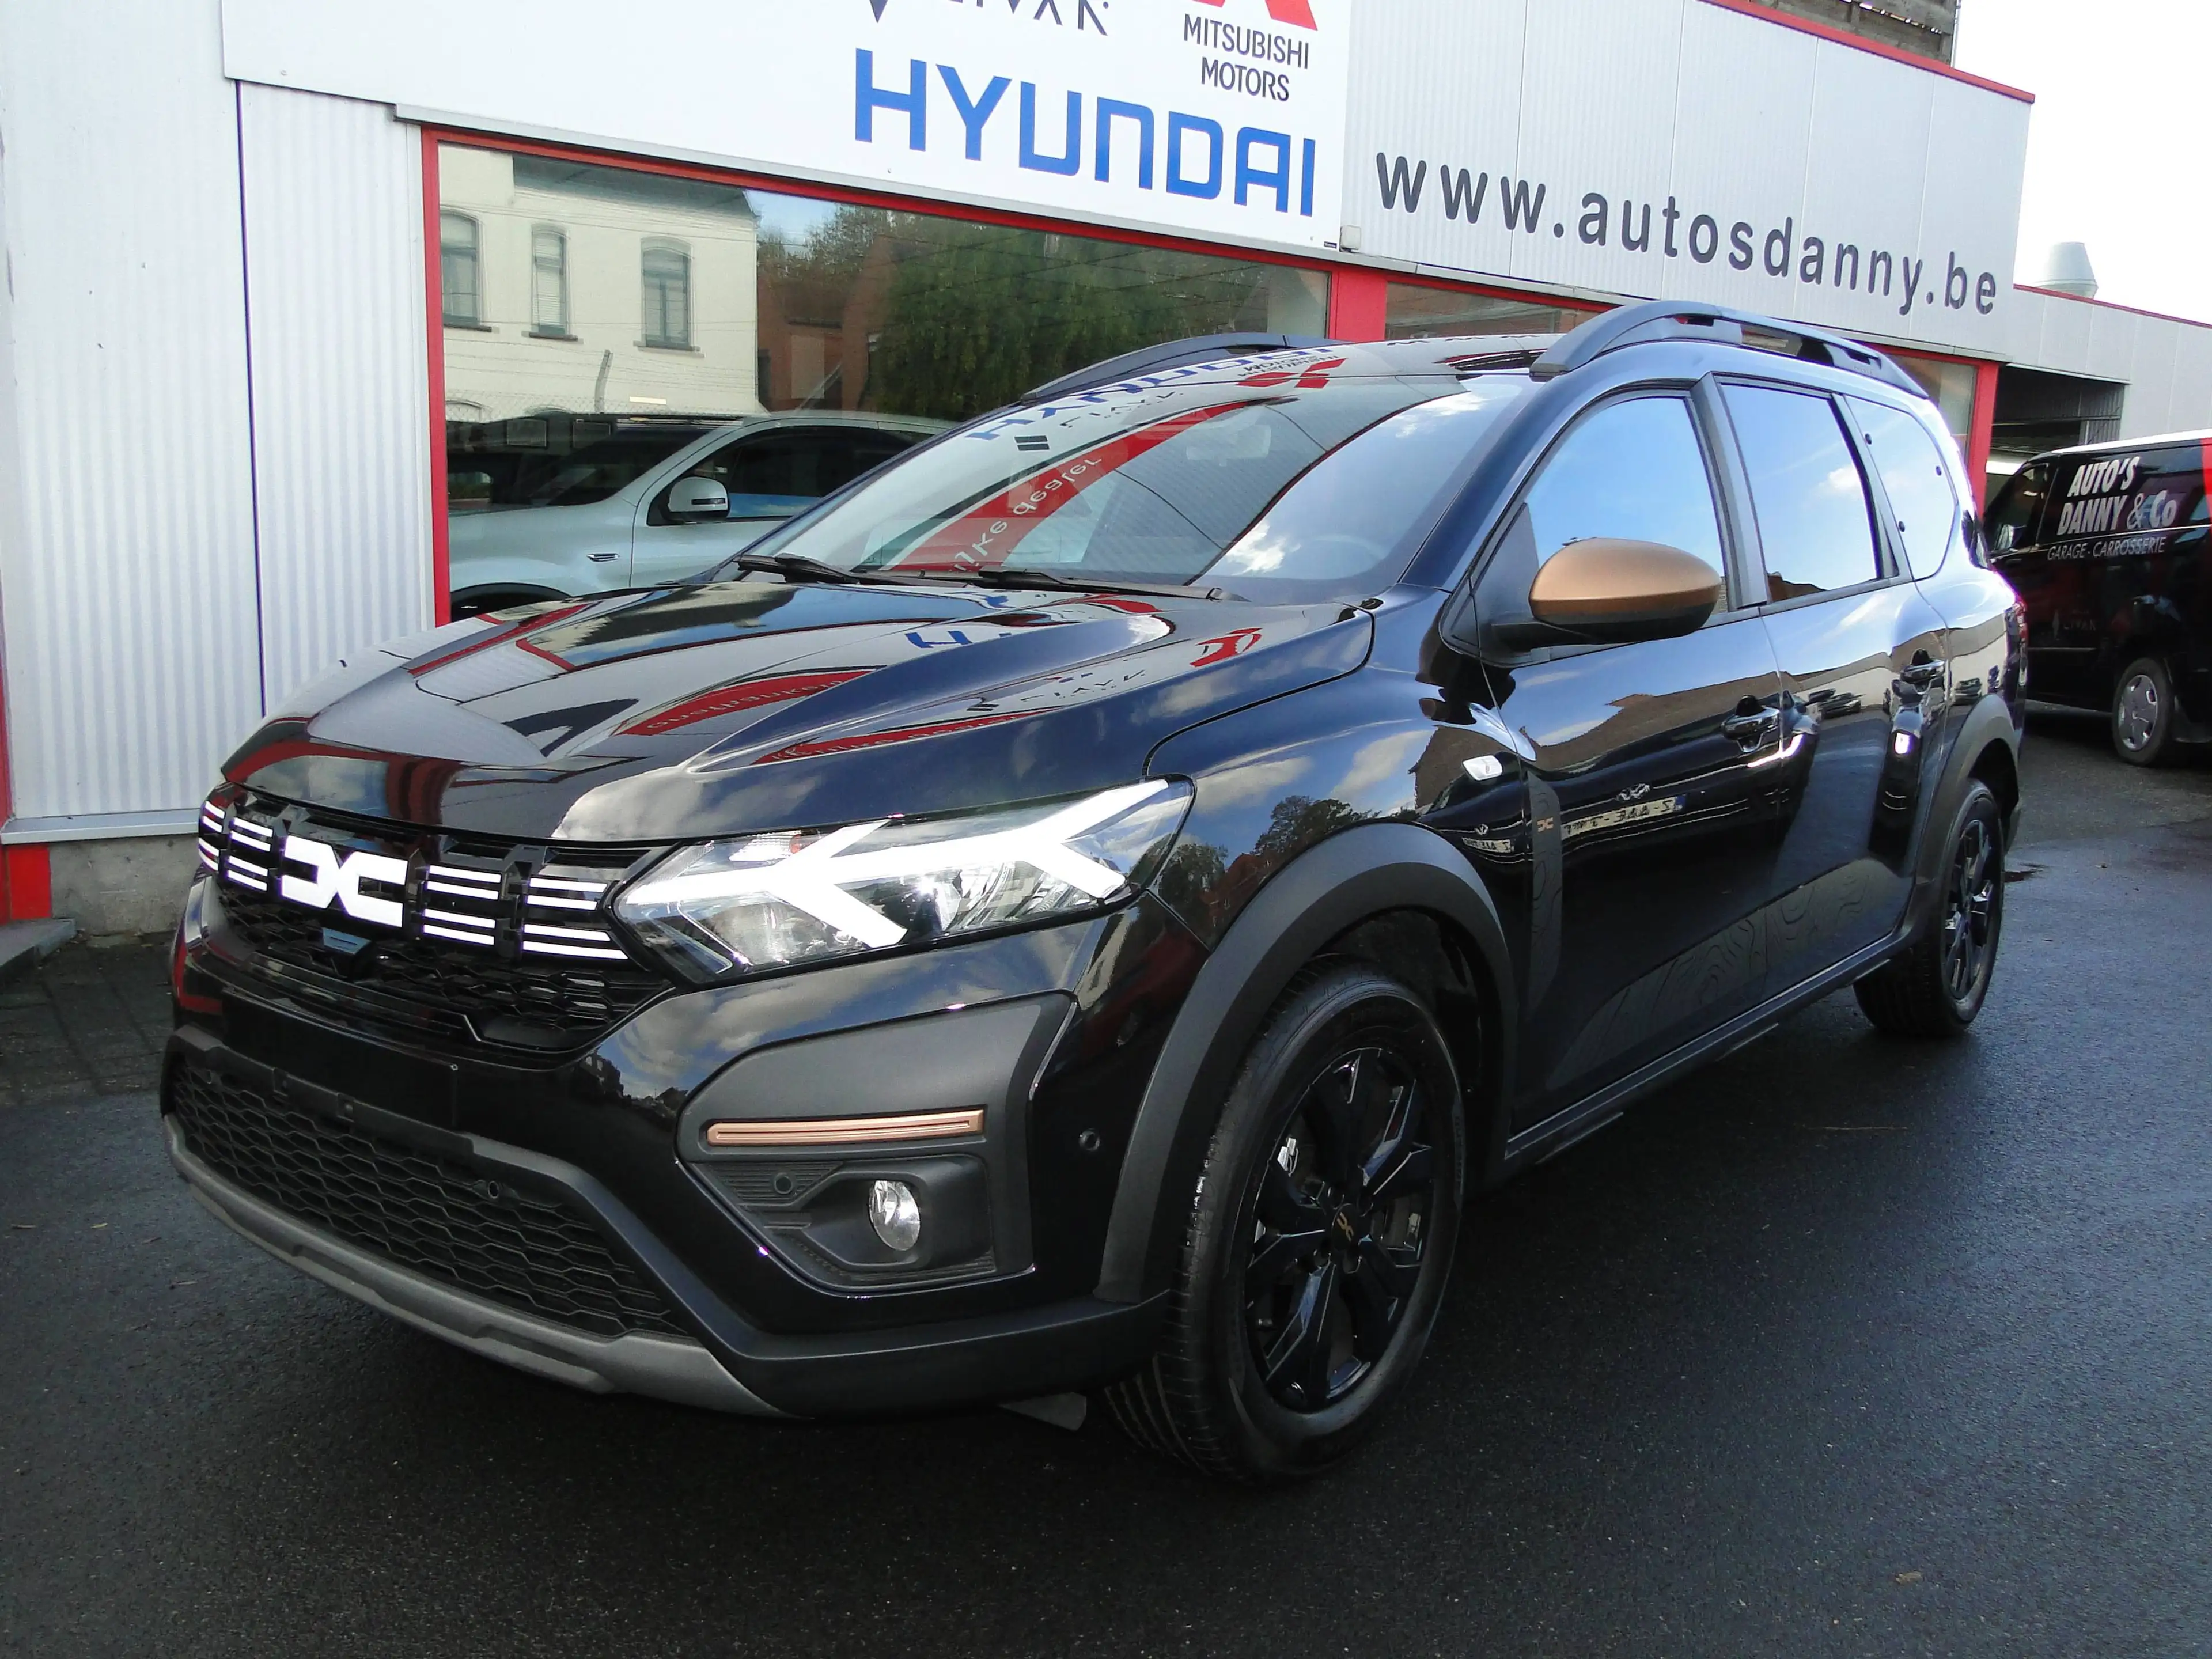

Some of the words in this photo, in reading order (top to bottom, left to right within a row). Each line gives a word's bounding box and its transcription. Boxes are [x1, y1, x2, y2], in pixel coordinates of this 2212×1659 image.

[1184, 13, 1309, 69] MITSUBISHI
[1201, 56, 1289, 102] MOTORS
[855, 48, 1316, 217] HYUNDAI
[1376, 152, 1996, 316] www.autosdanny.be
[2067, 456, 2140, 497] AUTO'S
[2056, 495, 2129, 535] DANNY
[2047, 543, 2088, 560] GARAGE
[2093, 536, 2167, 558] CARROSSERIE
